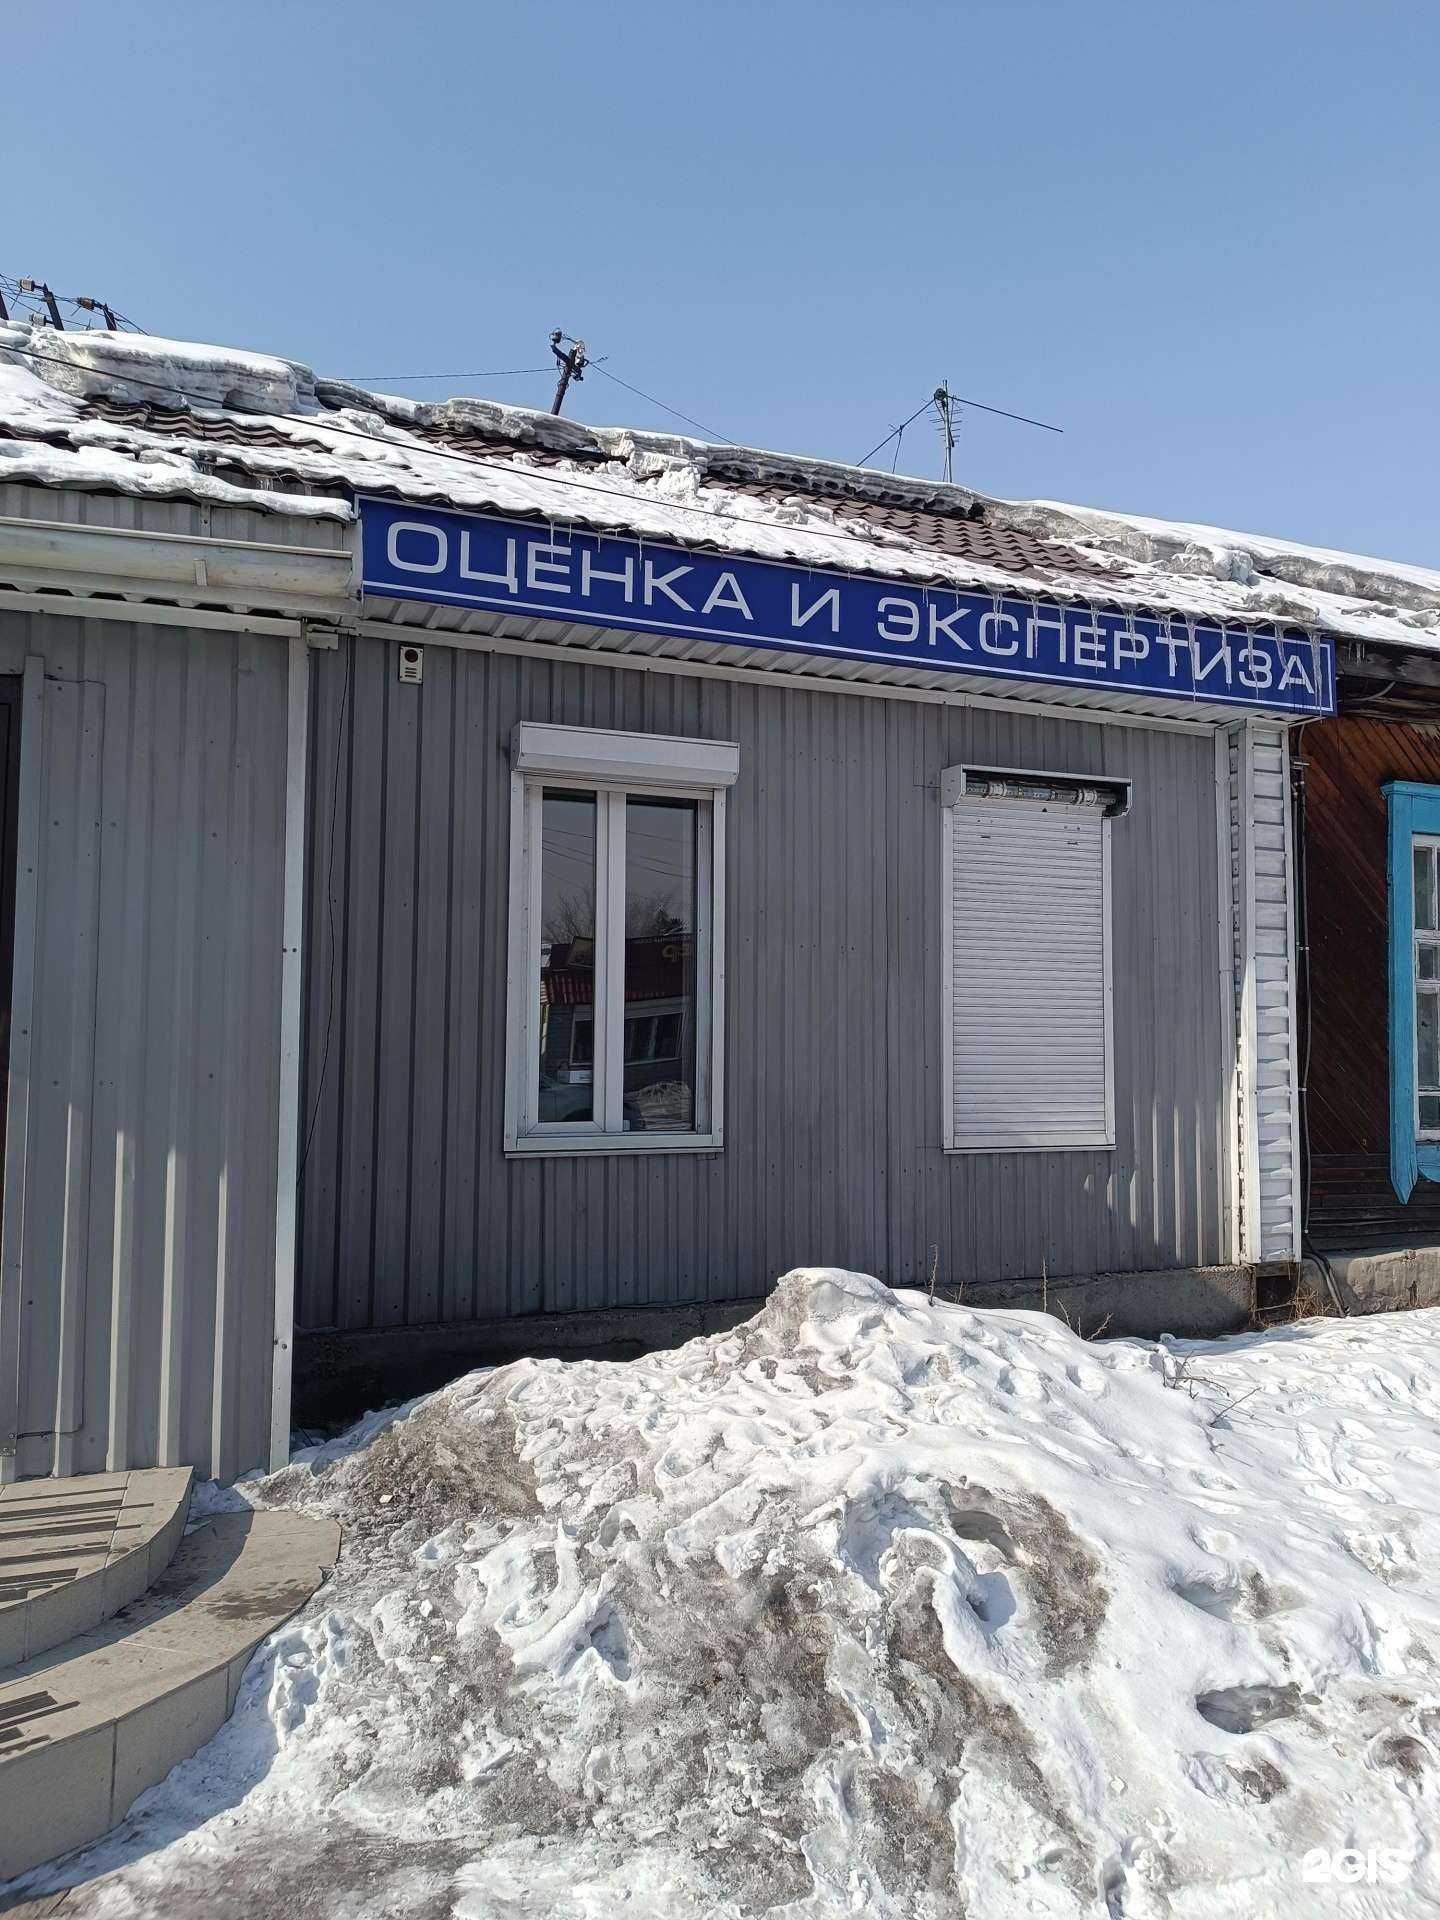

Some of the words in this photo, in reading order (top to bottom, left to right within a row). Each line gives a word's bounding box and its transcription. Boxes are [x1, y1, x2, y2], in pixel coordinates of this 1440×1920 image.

[386, 521, 754, 621] ОЦЕНКА
[791, 582, 840, 633] И
[876, 597, 1315, 694] ЭКСПЕРТИЗА
